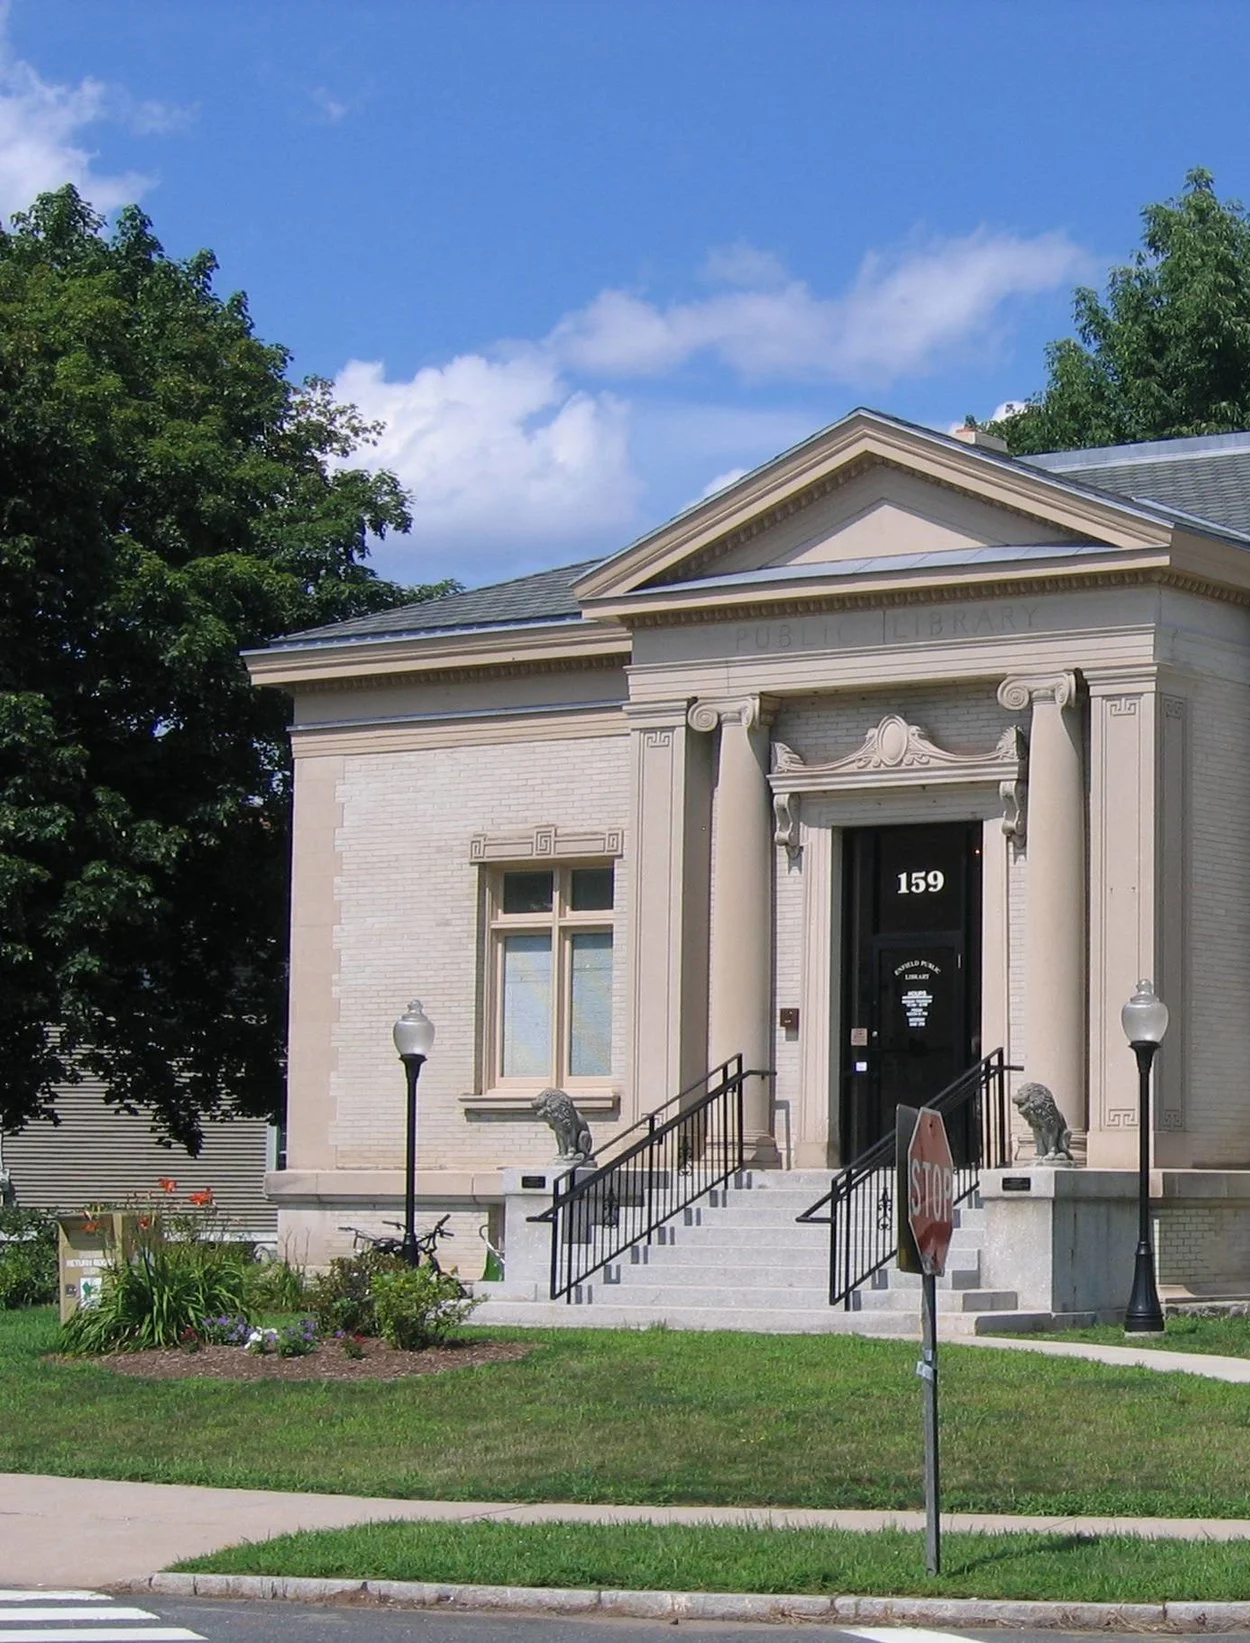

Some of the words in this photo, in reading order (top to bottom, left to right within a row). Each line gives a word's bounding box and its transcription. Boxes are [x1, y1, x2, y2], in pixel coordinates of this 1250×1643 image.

[736, 621, 852, 650] PUBLIC
[892, 604, 1038, 639] LIBRARY
[897, 870, 944, 893] 159
[920, 960, 941, 975] PUBLIC
[911, 1158, 952, 1223] STOP
